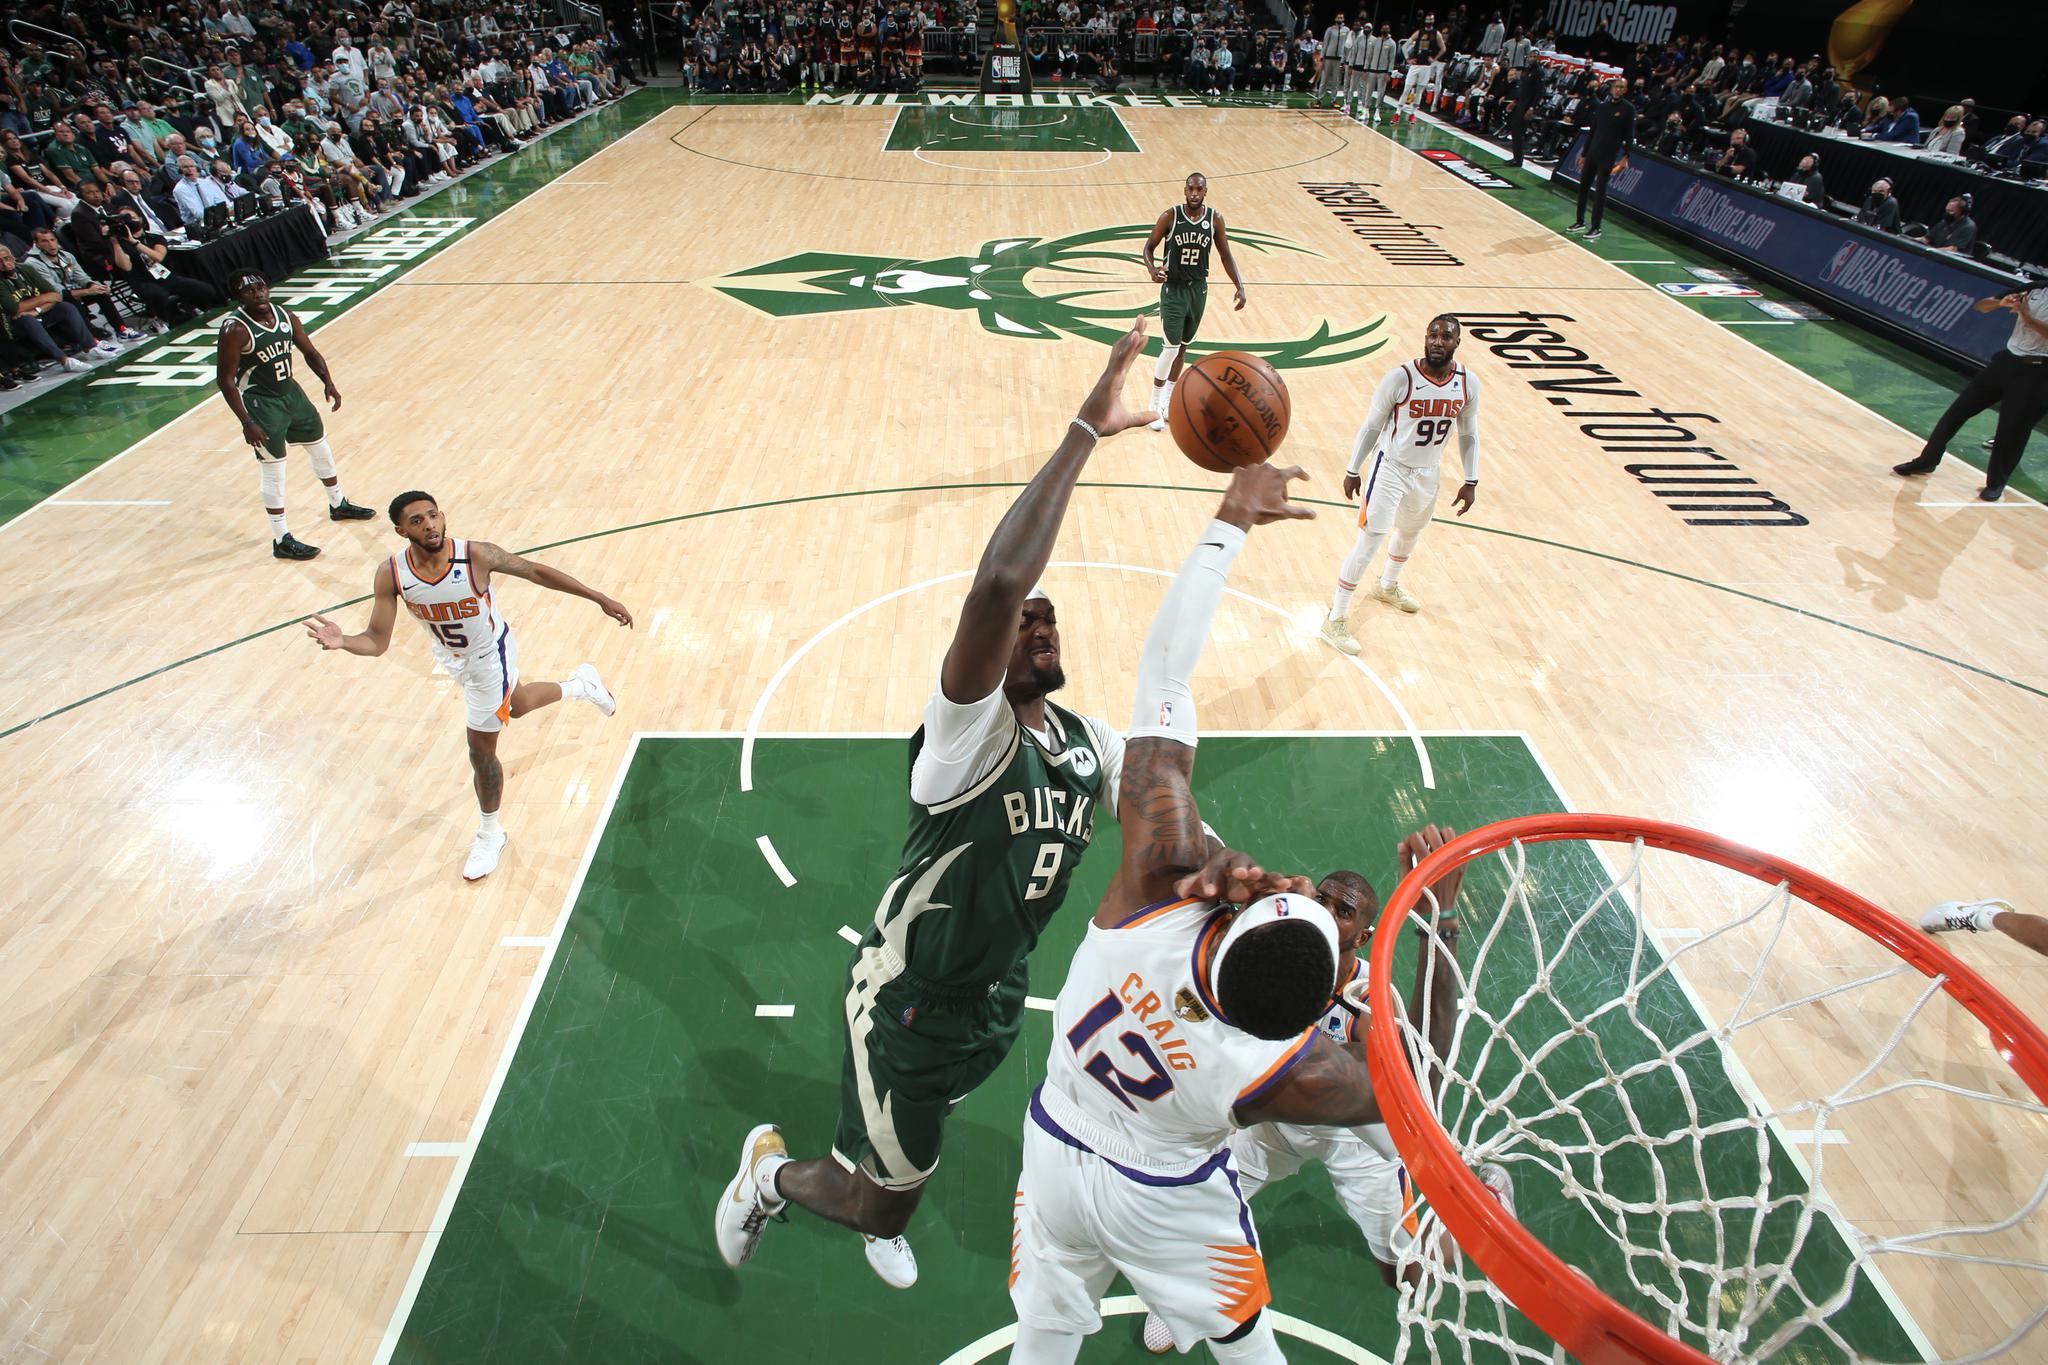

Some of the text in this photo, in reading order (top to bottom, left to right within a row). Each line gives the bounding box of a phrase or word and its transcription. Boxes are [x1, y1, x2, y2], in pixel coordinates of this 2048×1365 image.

[804, 93, 1209, 107] MILWAUKEE
[1681, 186, 1776, 250] NBAStore.com
[1174, 231, 1211, 248] BUCKS
[1180, 248, 1200, 266] 22
[1833, 246, 1975, 331] NBAStore.com
[256, 340, 293, 363] BUCK
[274, 358, 291, 382] 21
[1216, 366, 1282, 440] SPALDING
[1415, 420, 1452, 447] 99
[430, 621, 469, 649] 15
[1024, 843, 1065, 900] 9
[1119, 972, 1197, 1072] CRAIG
[1066, 988, 1174, 1113] 12
